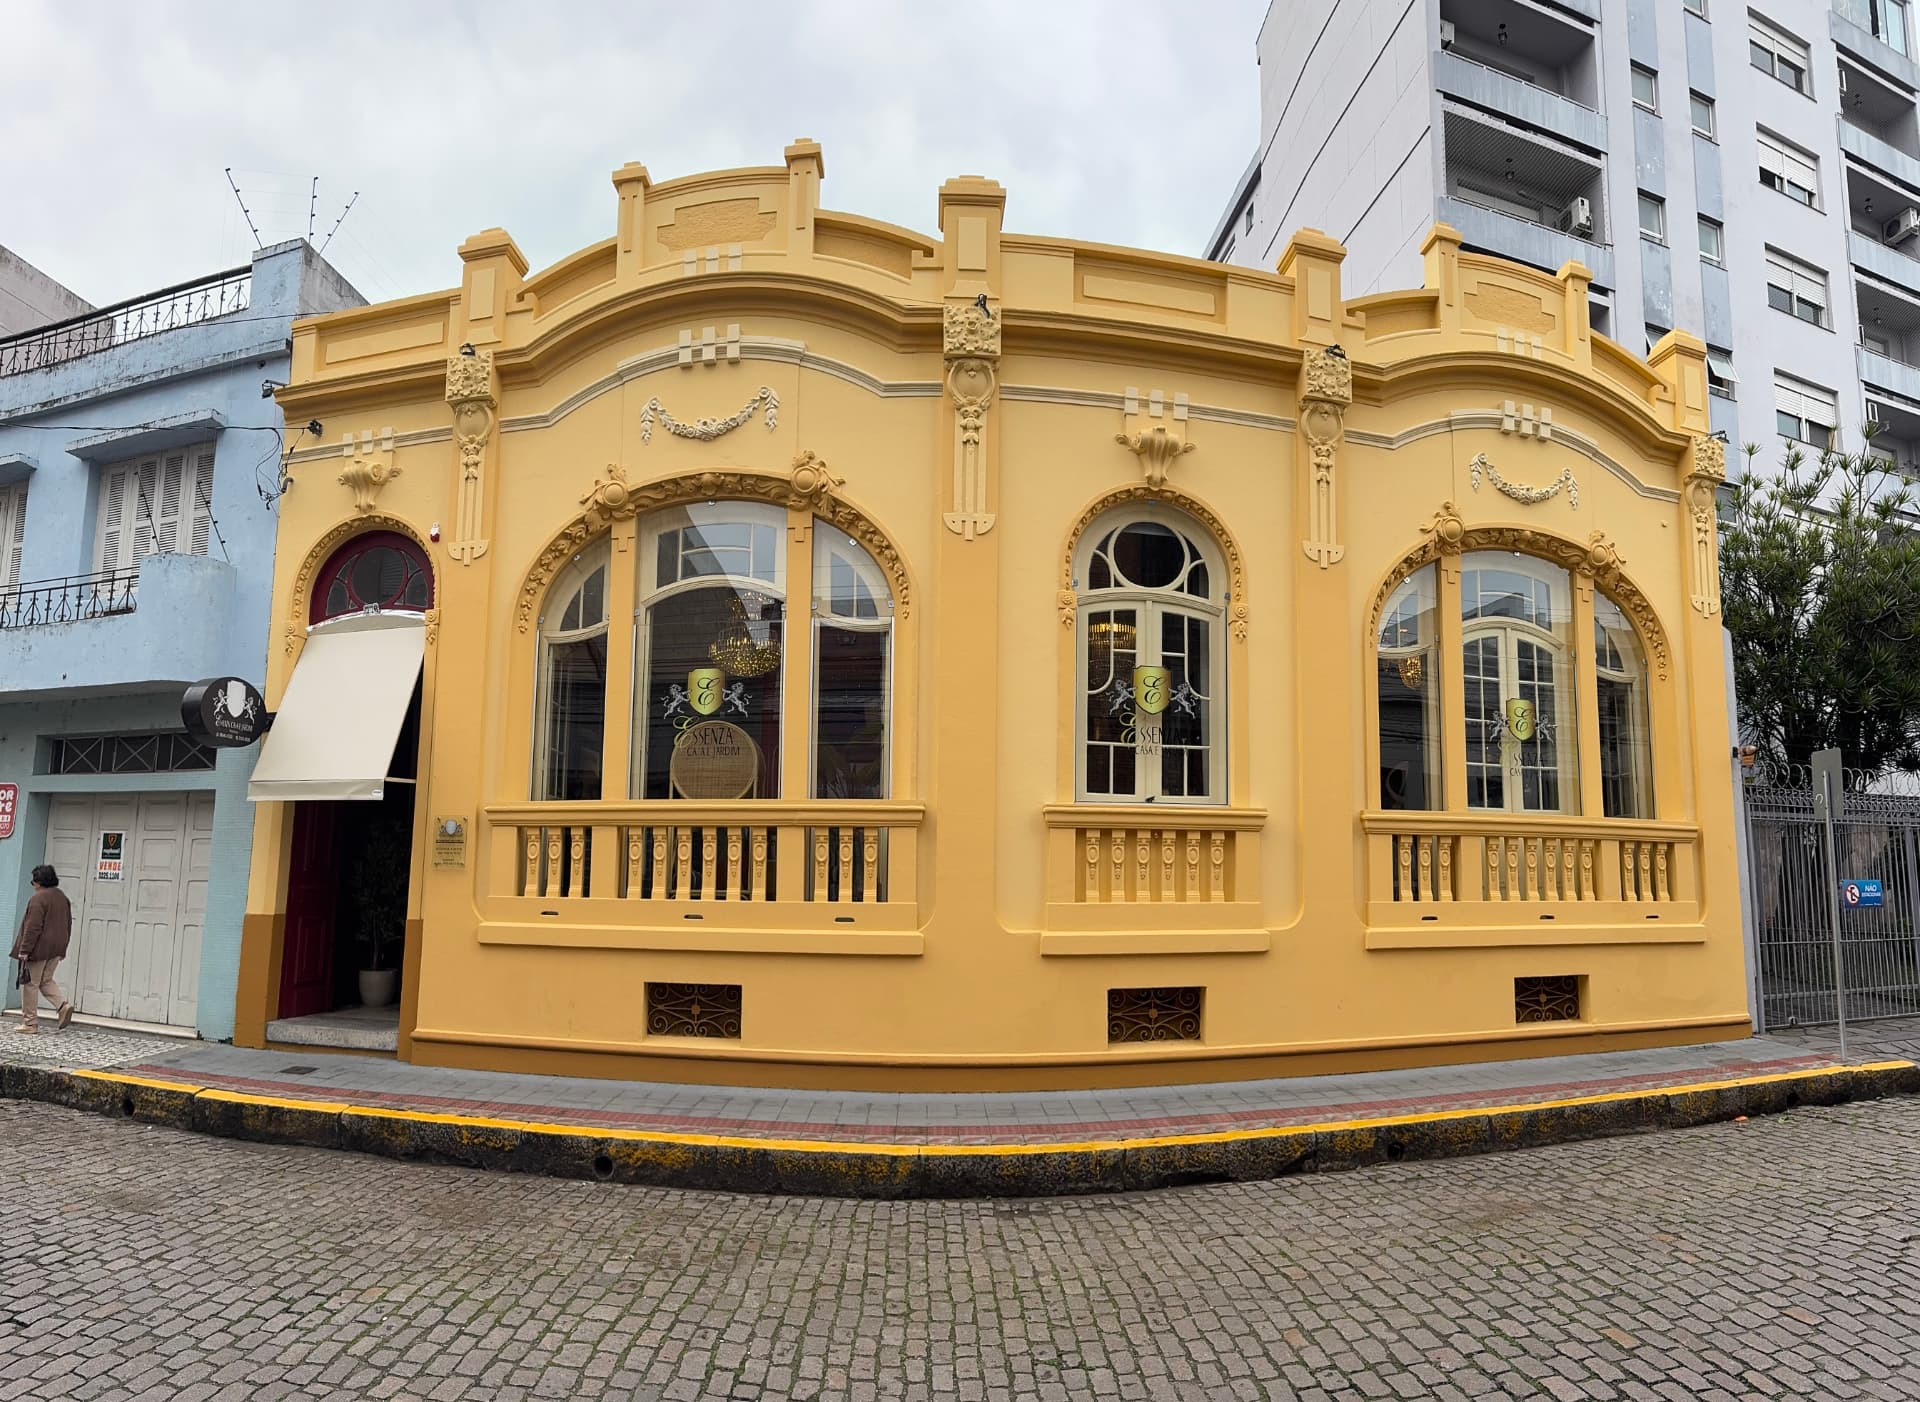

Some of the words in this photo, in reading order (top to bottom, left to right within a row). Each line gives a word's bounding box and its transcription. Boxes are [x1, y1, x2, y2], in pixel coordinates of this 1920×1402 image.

[698, 677, 720, 708] E
[1143, 676, 1167, 707] E
[673, 715, 733, 747] ESSENZA
[1513, 706, 1532, 733] E
[686, 746, 706, 757] CAA
[99, 860, 122, 871] VENDE
